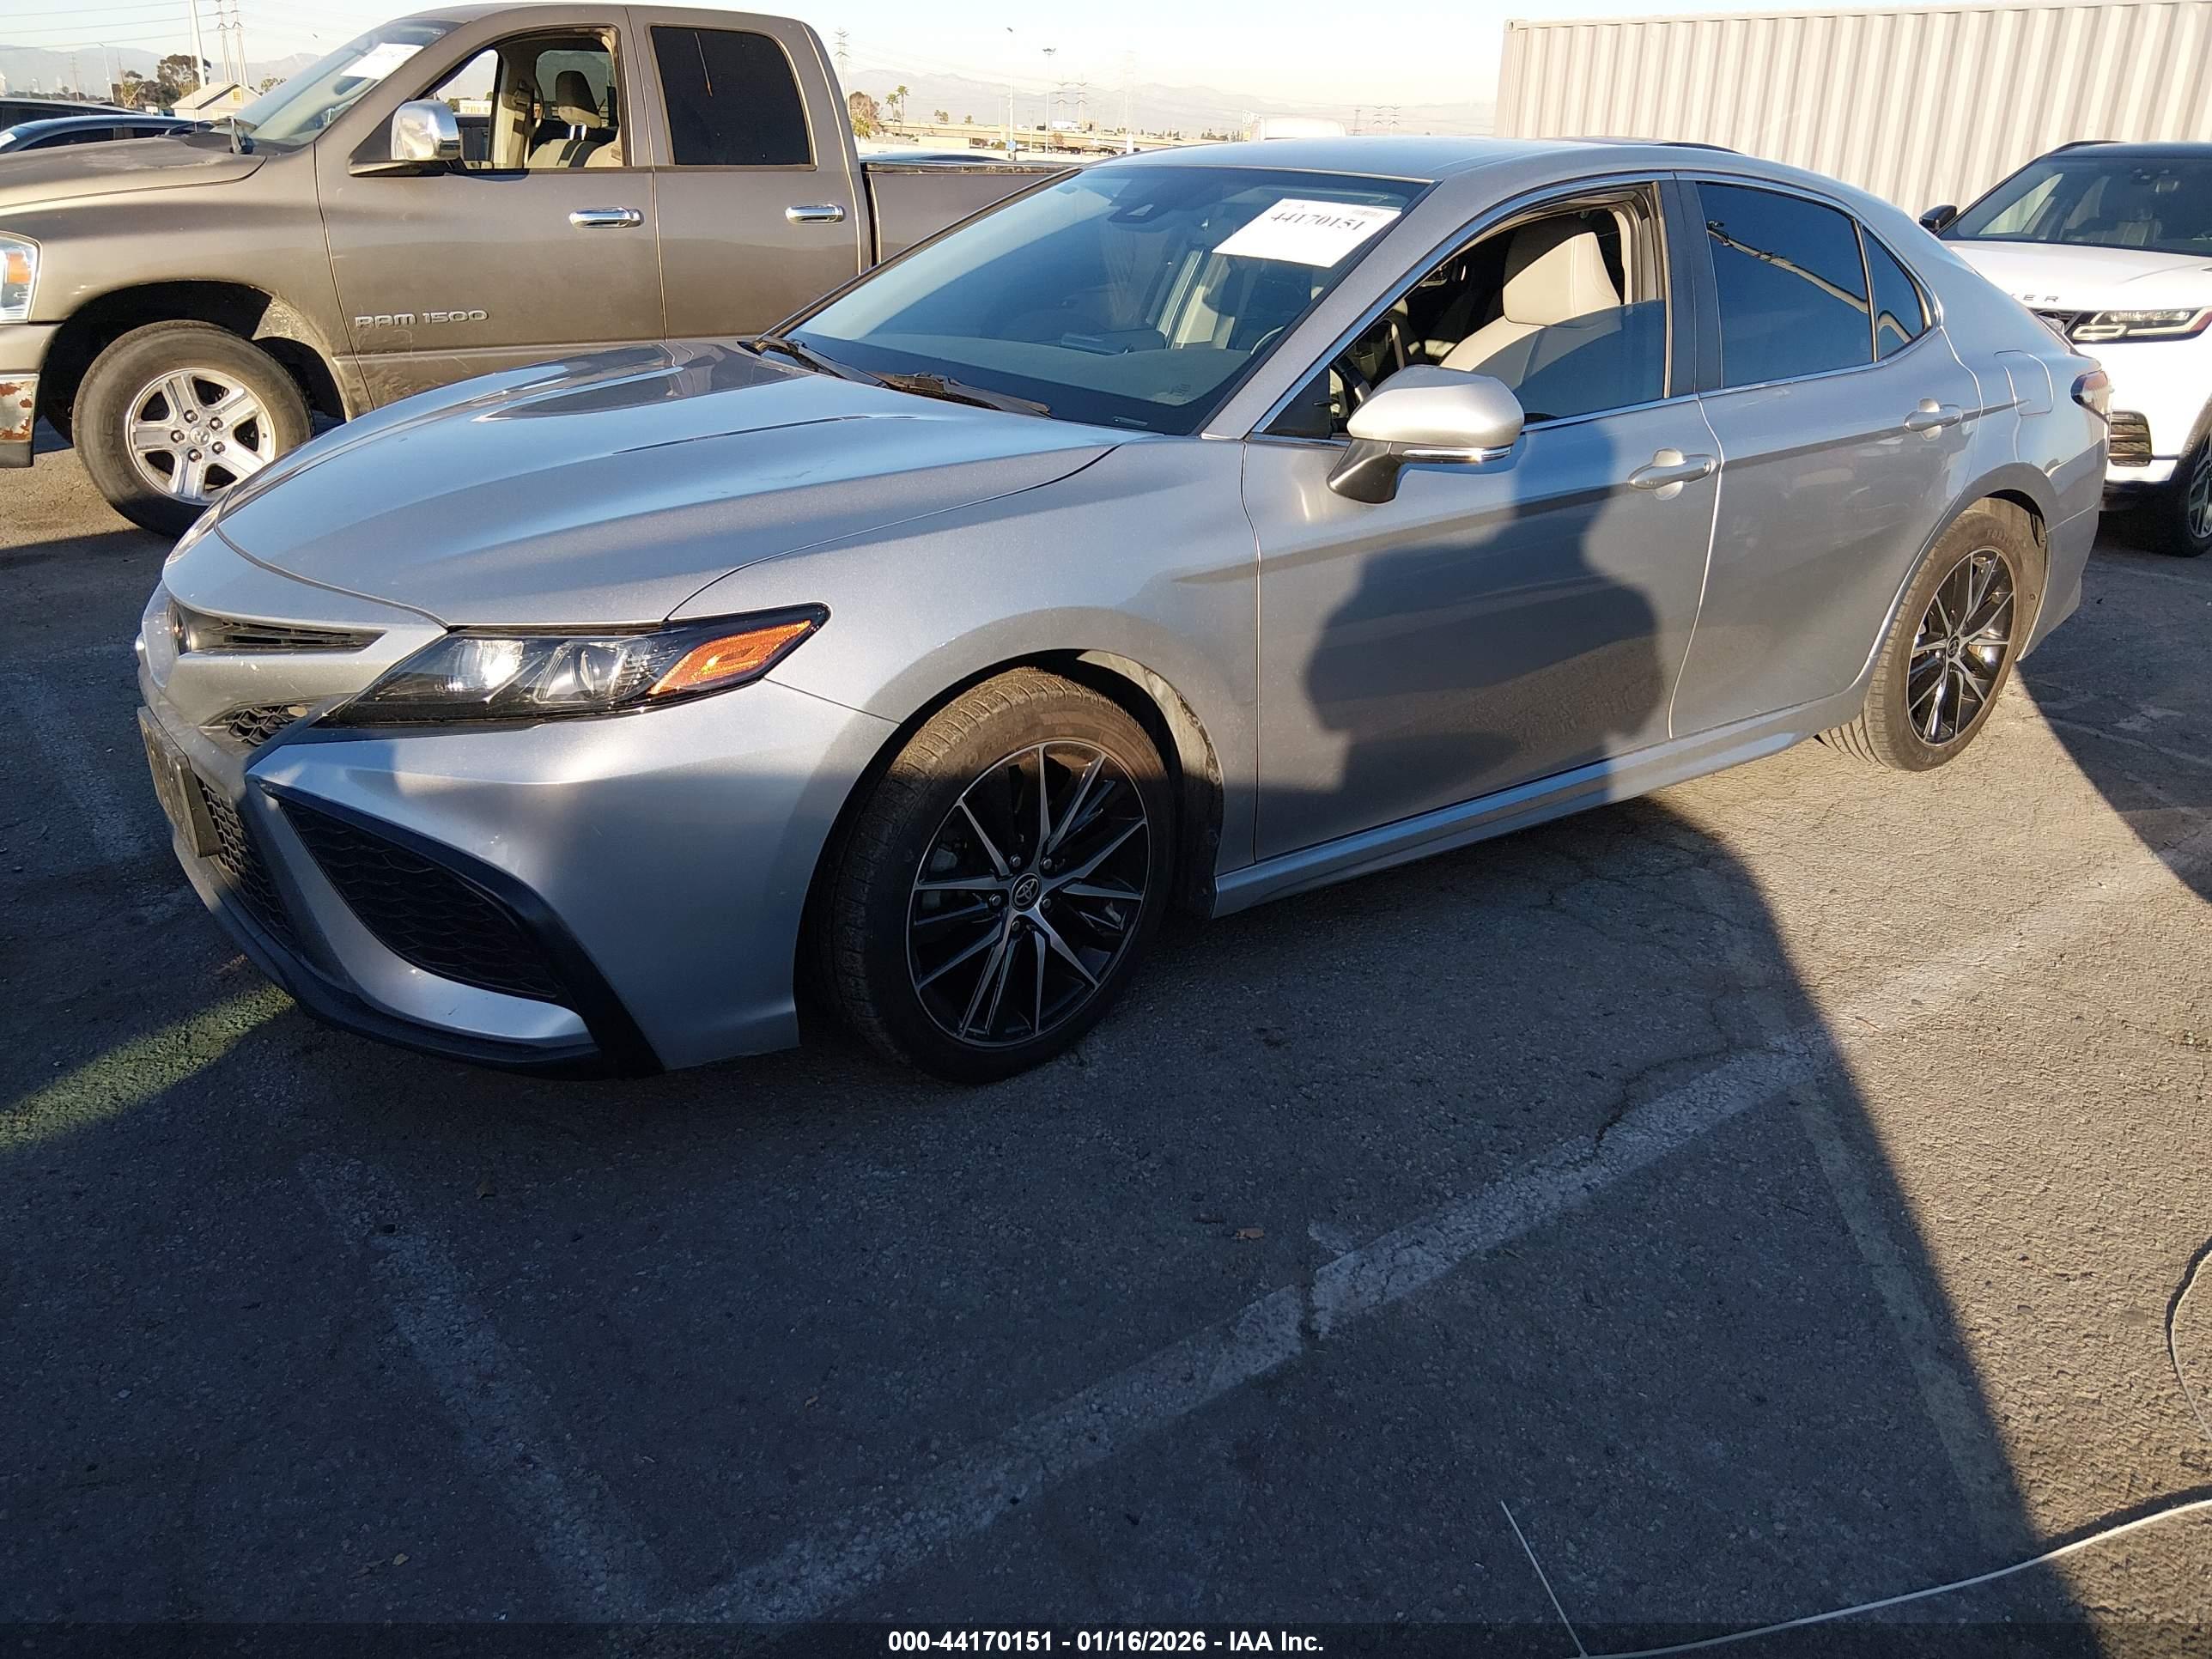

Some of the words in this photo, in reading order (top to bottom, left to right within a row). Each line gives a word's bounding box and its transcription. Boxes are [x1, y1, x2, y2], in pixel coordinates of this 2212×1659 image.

[1271, 212, 1366, 230] 44170151
[355, 313, 416, 328] RAM
[422, 309, 489, 324] 1500
